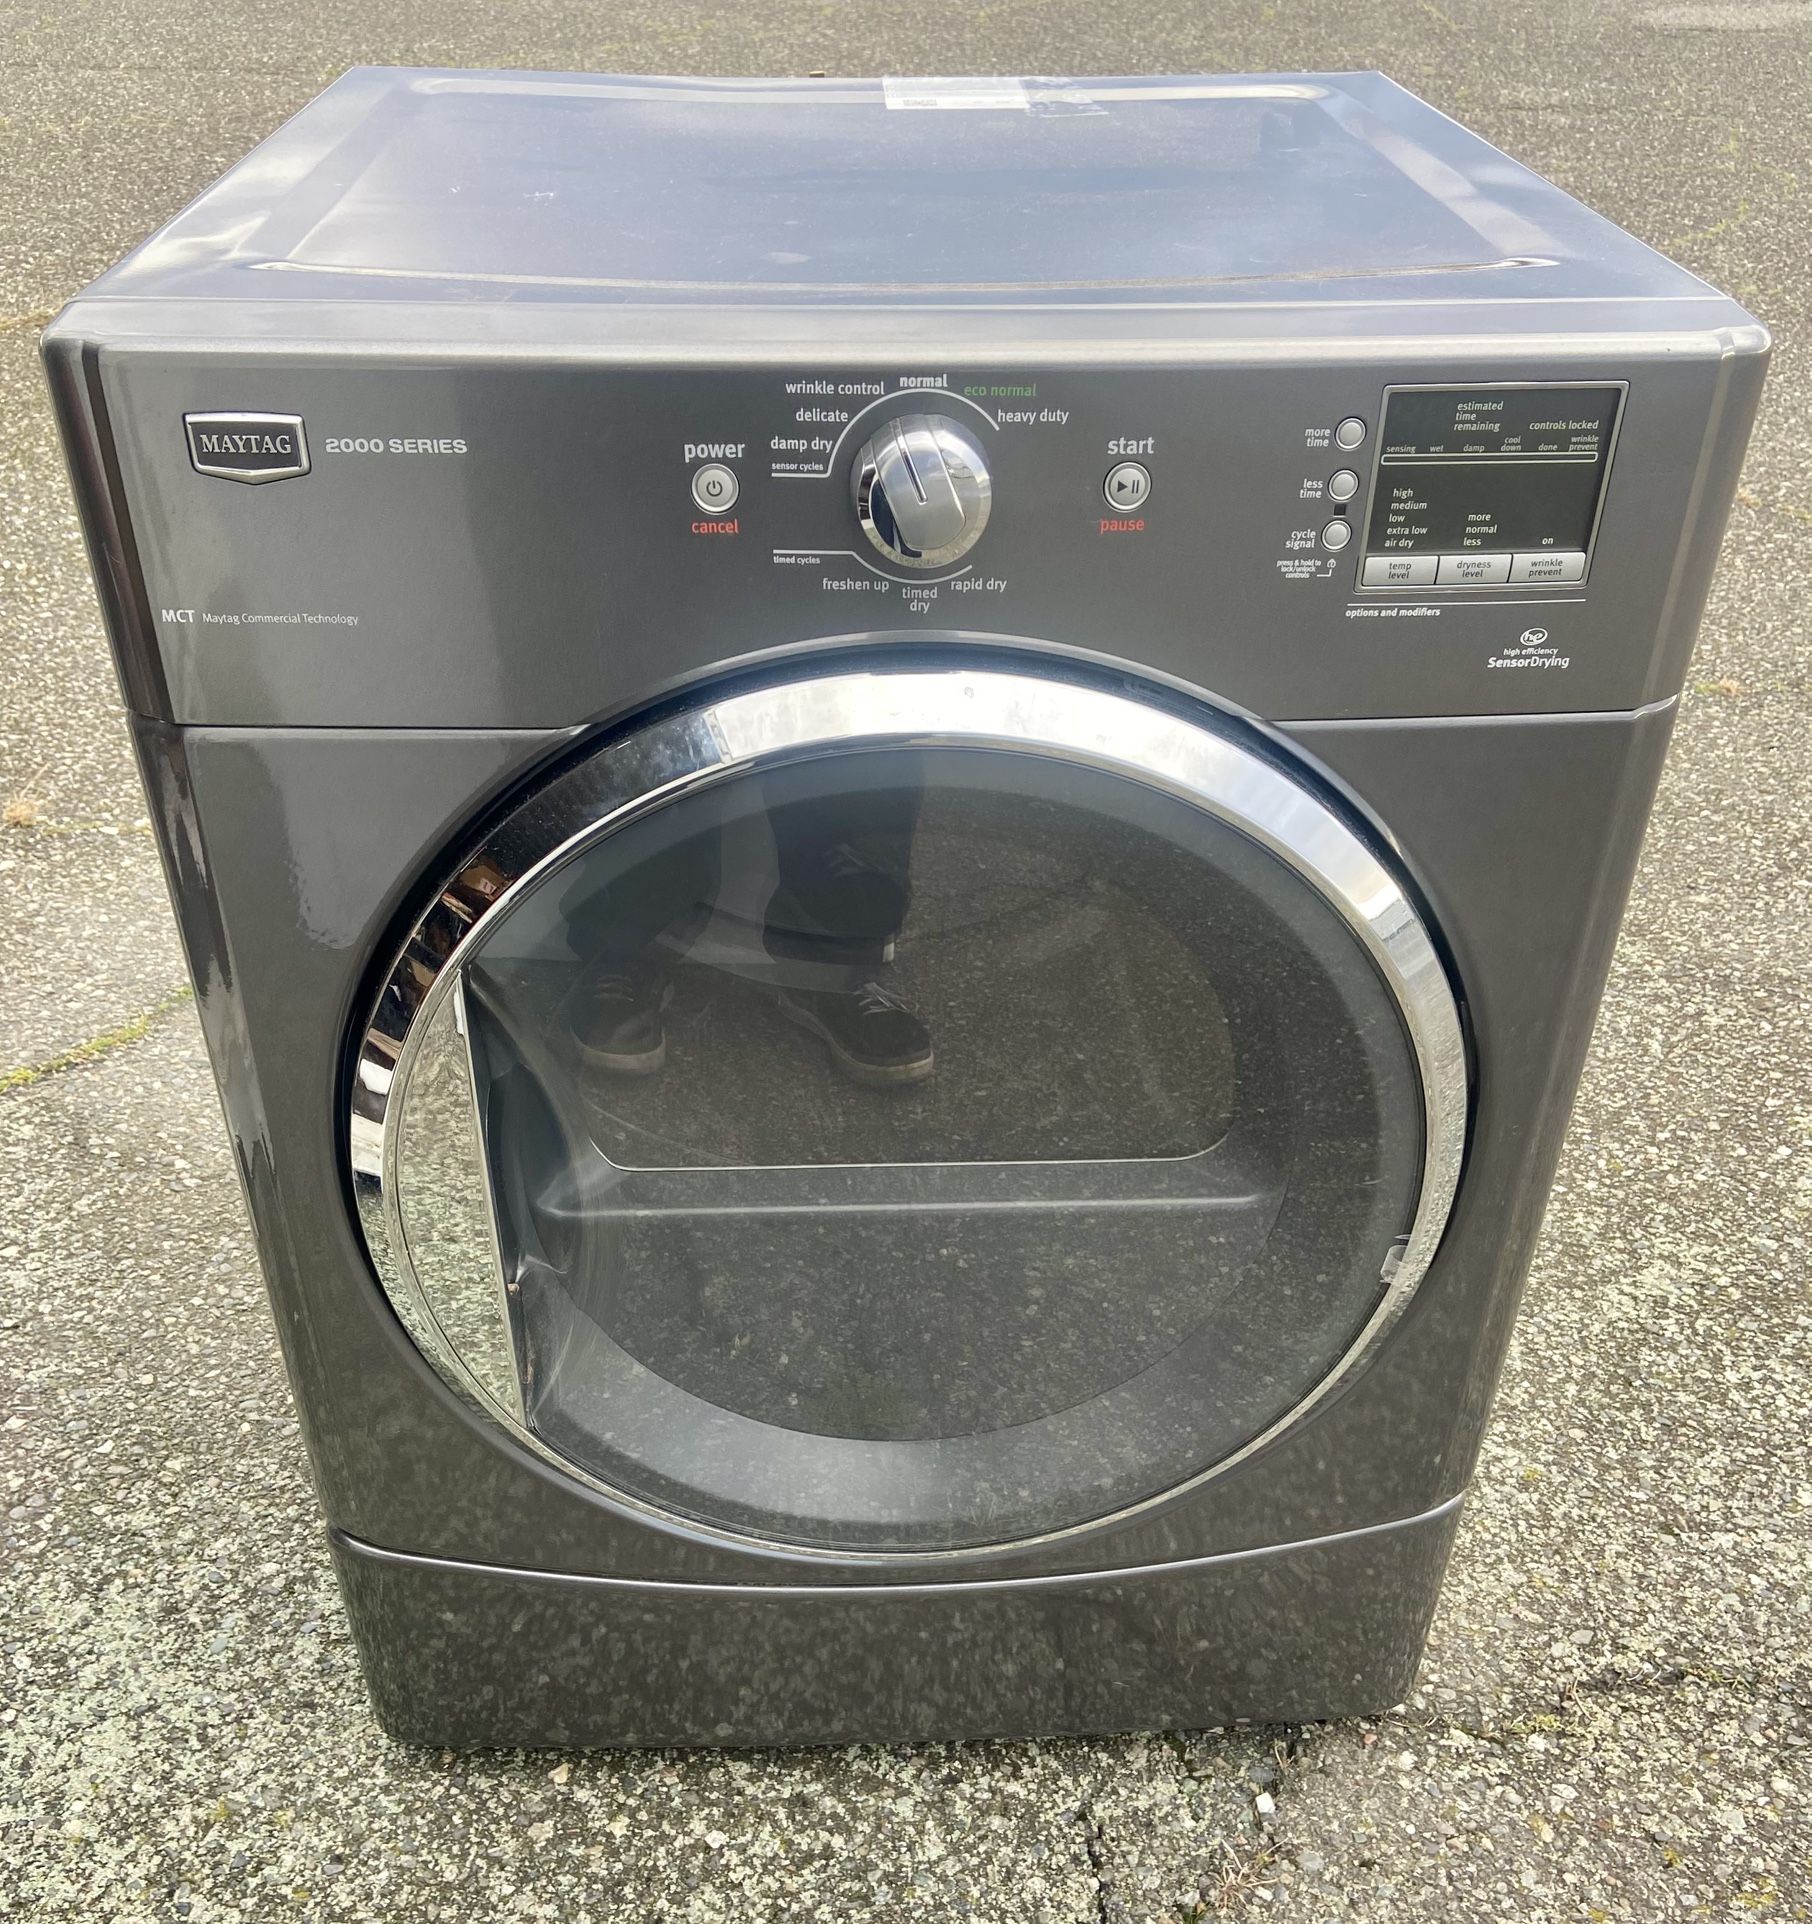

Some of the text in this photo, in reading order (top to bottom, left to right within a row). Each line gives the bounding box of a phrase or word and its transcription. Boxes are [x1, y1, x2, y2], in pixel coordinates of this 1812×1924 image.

[899, 374, 948, 388] normal
[785, 381, 885, 395] wrinkle control
[964, 384, 1037, 398] eco normal
[1457, 401, 1503, 411] estimated
[796, 408, 849, 422] delicate
[998, 409, 1069, 425] heavy duty
[1456, 412, 1477, 420] time
[1454, 422, 1500, 432] remaining
[1530, 420, 1599, 430] controls locked
[1305, 428, 1331, 437] more
[200, 434, 292, 454] MAYTAG
[1307, 437, 1329, 447] time
[1505, 436, 1521, 444] cool
[1571, 435, 1599, 443] wrinkle
[325, 438, 468, 454] 2000 SERIES
[771, 436, 833, 453] damp dry
[1107, 437, 1154, 455] start
[1386, 445, 1416, 454] sensing
[1430, 445, 1444, 453] wet
[1463, 444, 1485, 453] damp
[1538, 443, 1558, 451] done
[1568, 443, 1598, 452] prevent
[683, 441, 745, 463] power
[772, 462, 824, 472] sensor cycles
[1303, 478, 1323, 489] less
[1300, 489, 1322, 499] time
[1393, 488, 1414, 499] high
[1391, 501, 1427, 510] medium
[1389, 513, 1405, 522] low
[1468, 513, 1491, 521] more
[691, 519, 739, 534] cancel
[1100, 518, 1145, 534] pause
[1387, 526, 1427, 535] extra low
[1466, 525, 1497, 534] normal
[1291, 529, 1316, 540] cycle
[1285, 538, 1315, 550] signal
[1385, 538, 1414, 548] air dry
[1463, 537, 1481, 546] less
[1542, 537, 1553, 545] on
[773, 556, 820, 565] timed cycles
[1277, 560, 1293, 568] press
[1300, 559, 1314, 567] hold
[1457, 561, 1491, 570] dryness
[1531, 559, 1563, 567] wrinkle
[1389, 562, 1412, 572] temp
[1285, 571, 1310, 579] controls
[1388, 571, 1409, 580] level
[1462, 570, 1483, 578] level
[1528, 568, 1562, 578] prevent
[822, 578, 890, 592] freshen up
[951, 578, 1007, 593] rapid dry
[902, 587, 938, 599] timed
[910, 600, 930, 613] dry
[162, 609, 195, 623] MCT
[1345, 607, 1440, 619] options and modifiers
[202, 613, 358, 626] Maytag Commercial Technology
[1503, 647, 1558, 656] high efficiency
[1487, 656, 1570, 669] SensorDrying
